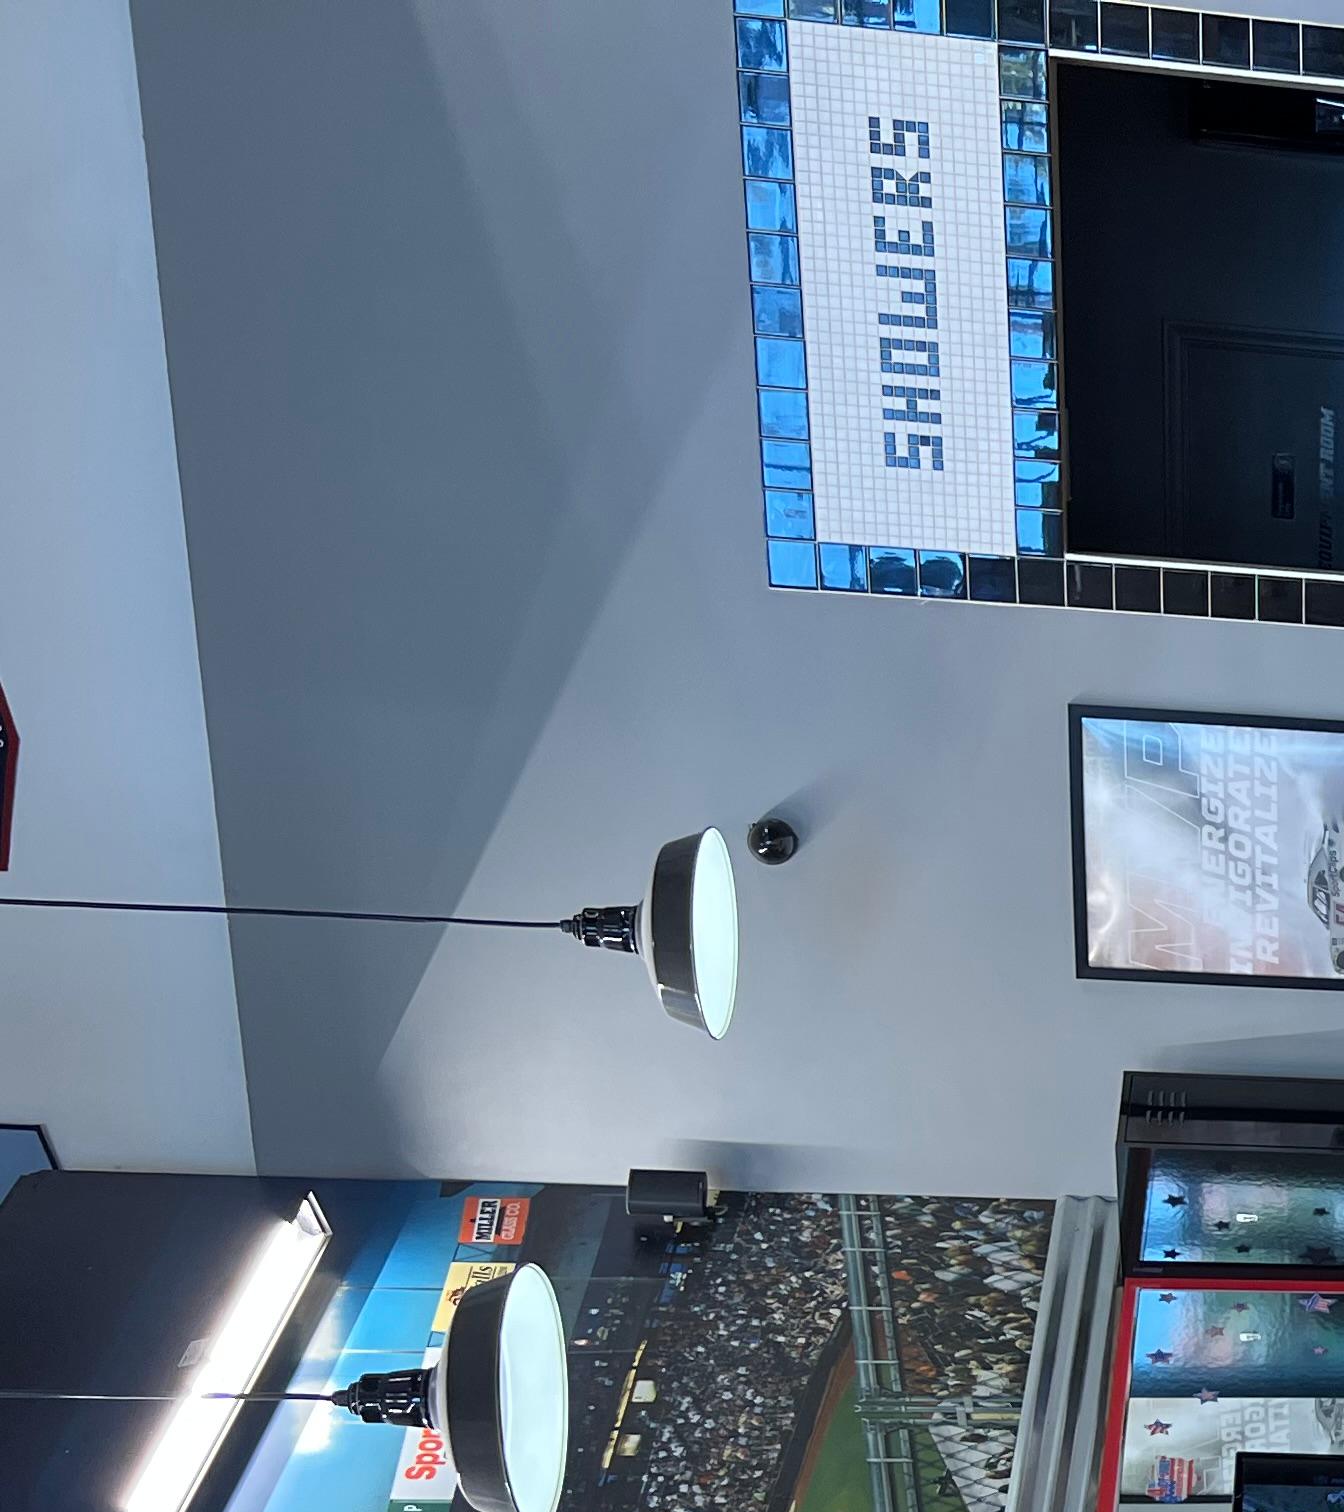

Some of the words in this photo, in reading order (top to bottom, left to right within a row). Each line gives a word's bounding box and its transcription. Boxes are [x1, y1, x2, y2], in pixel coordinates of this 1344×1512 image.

[868, 116, 944, 471] SHOWERS
[1319, 405, 1335, 462] ROOM
[475, 1200, 498, 1240] MILLER
[501, 1219, 519, 1240] GLASS
[404, 1426, 446, 1481] Spor
